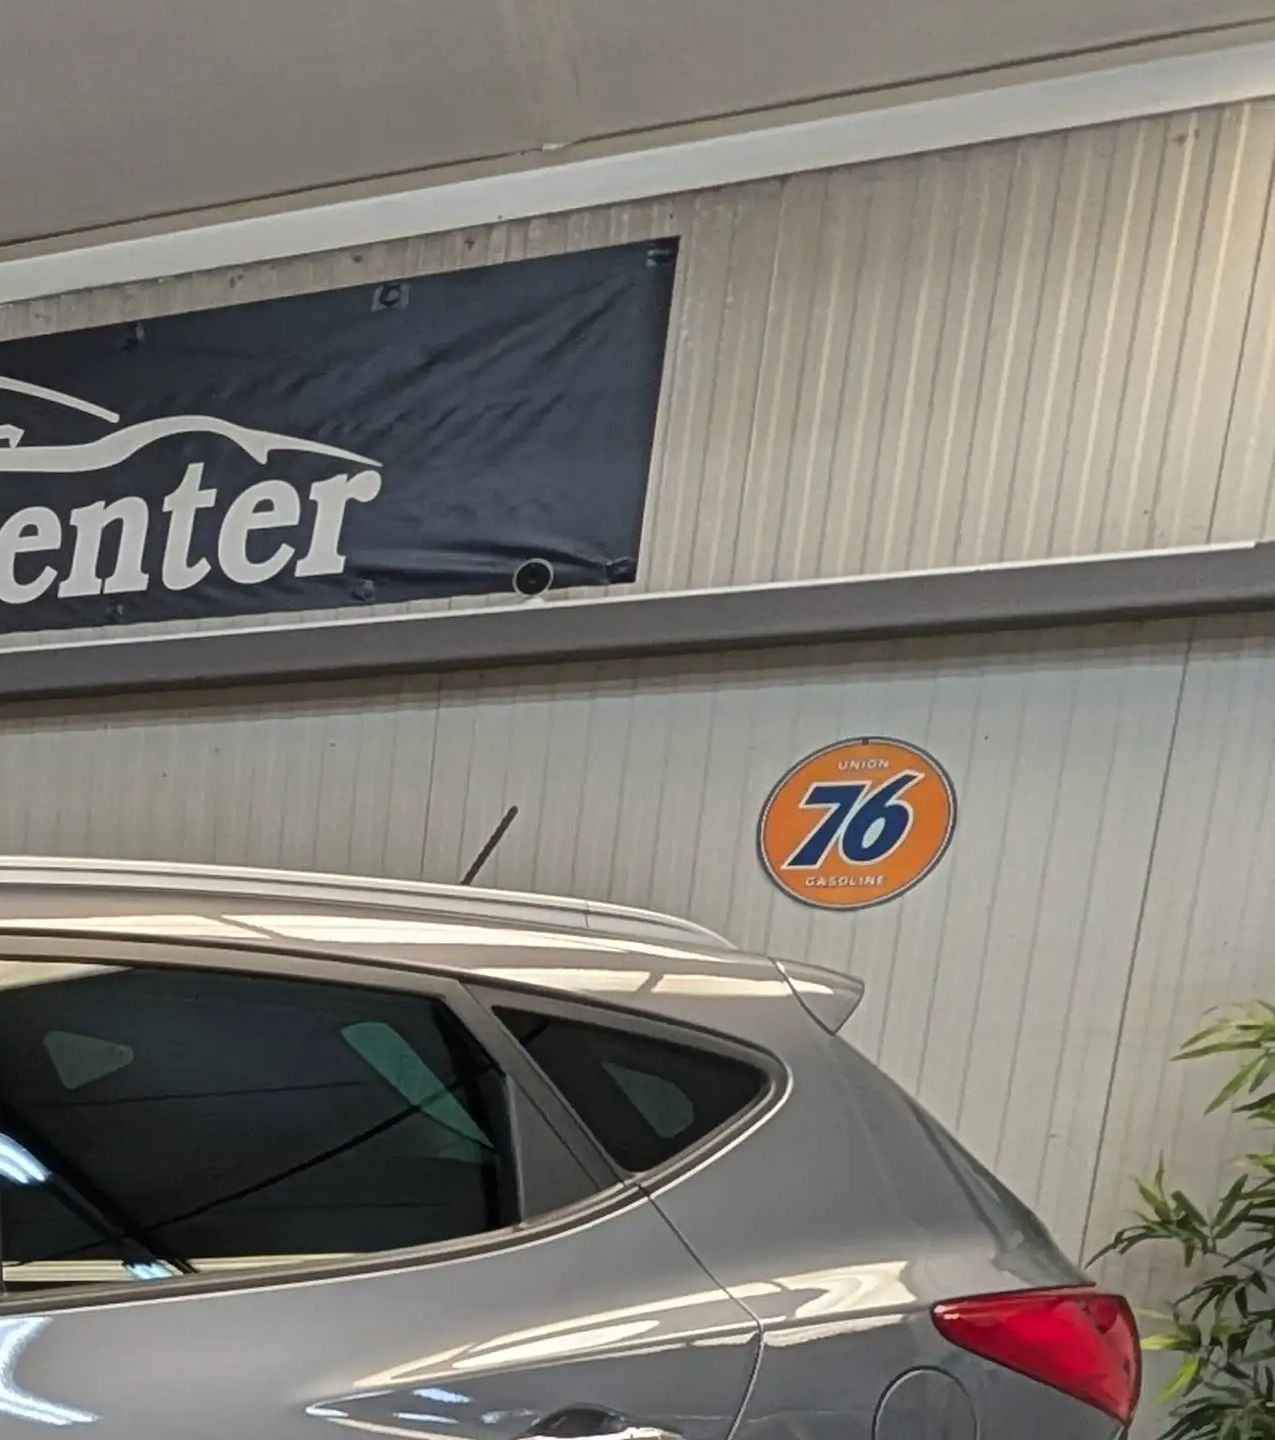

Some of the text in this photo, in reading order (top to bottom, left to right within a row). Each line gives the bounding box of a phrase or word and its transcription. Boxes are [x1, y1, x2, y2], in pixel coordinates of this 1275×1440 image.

[837, 759, 889, 770] UNION
[780, 768, 925, 870] 76
[805, 875, 885, 887] GASOLINE
